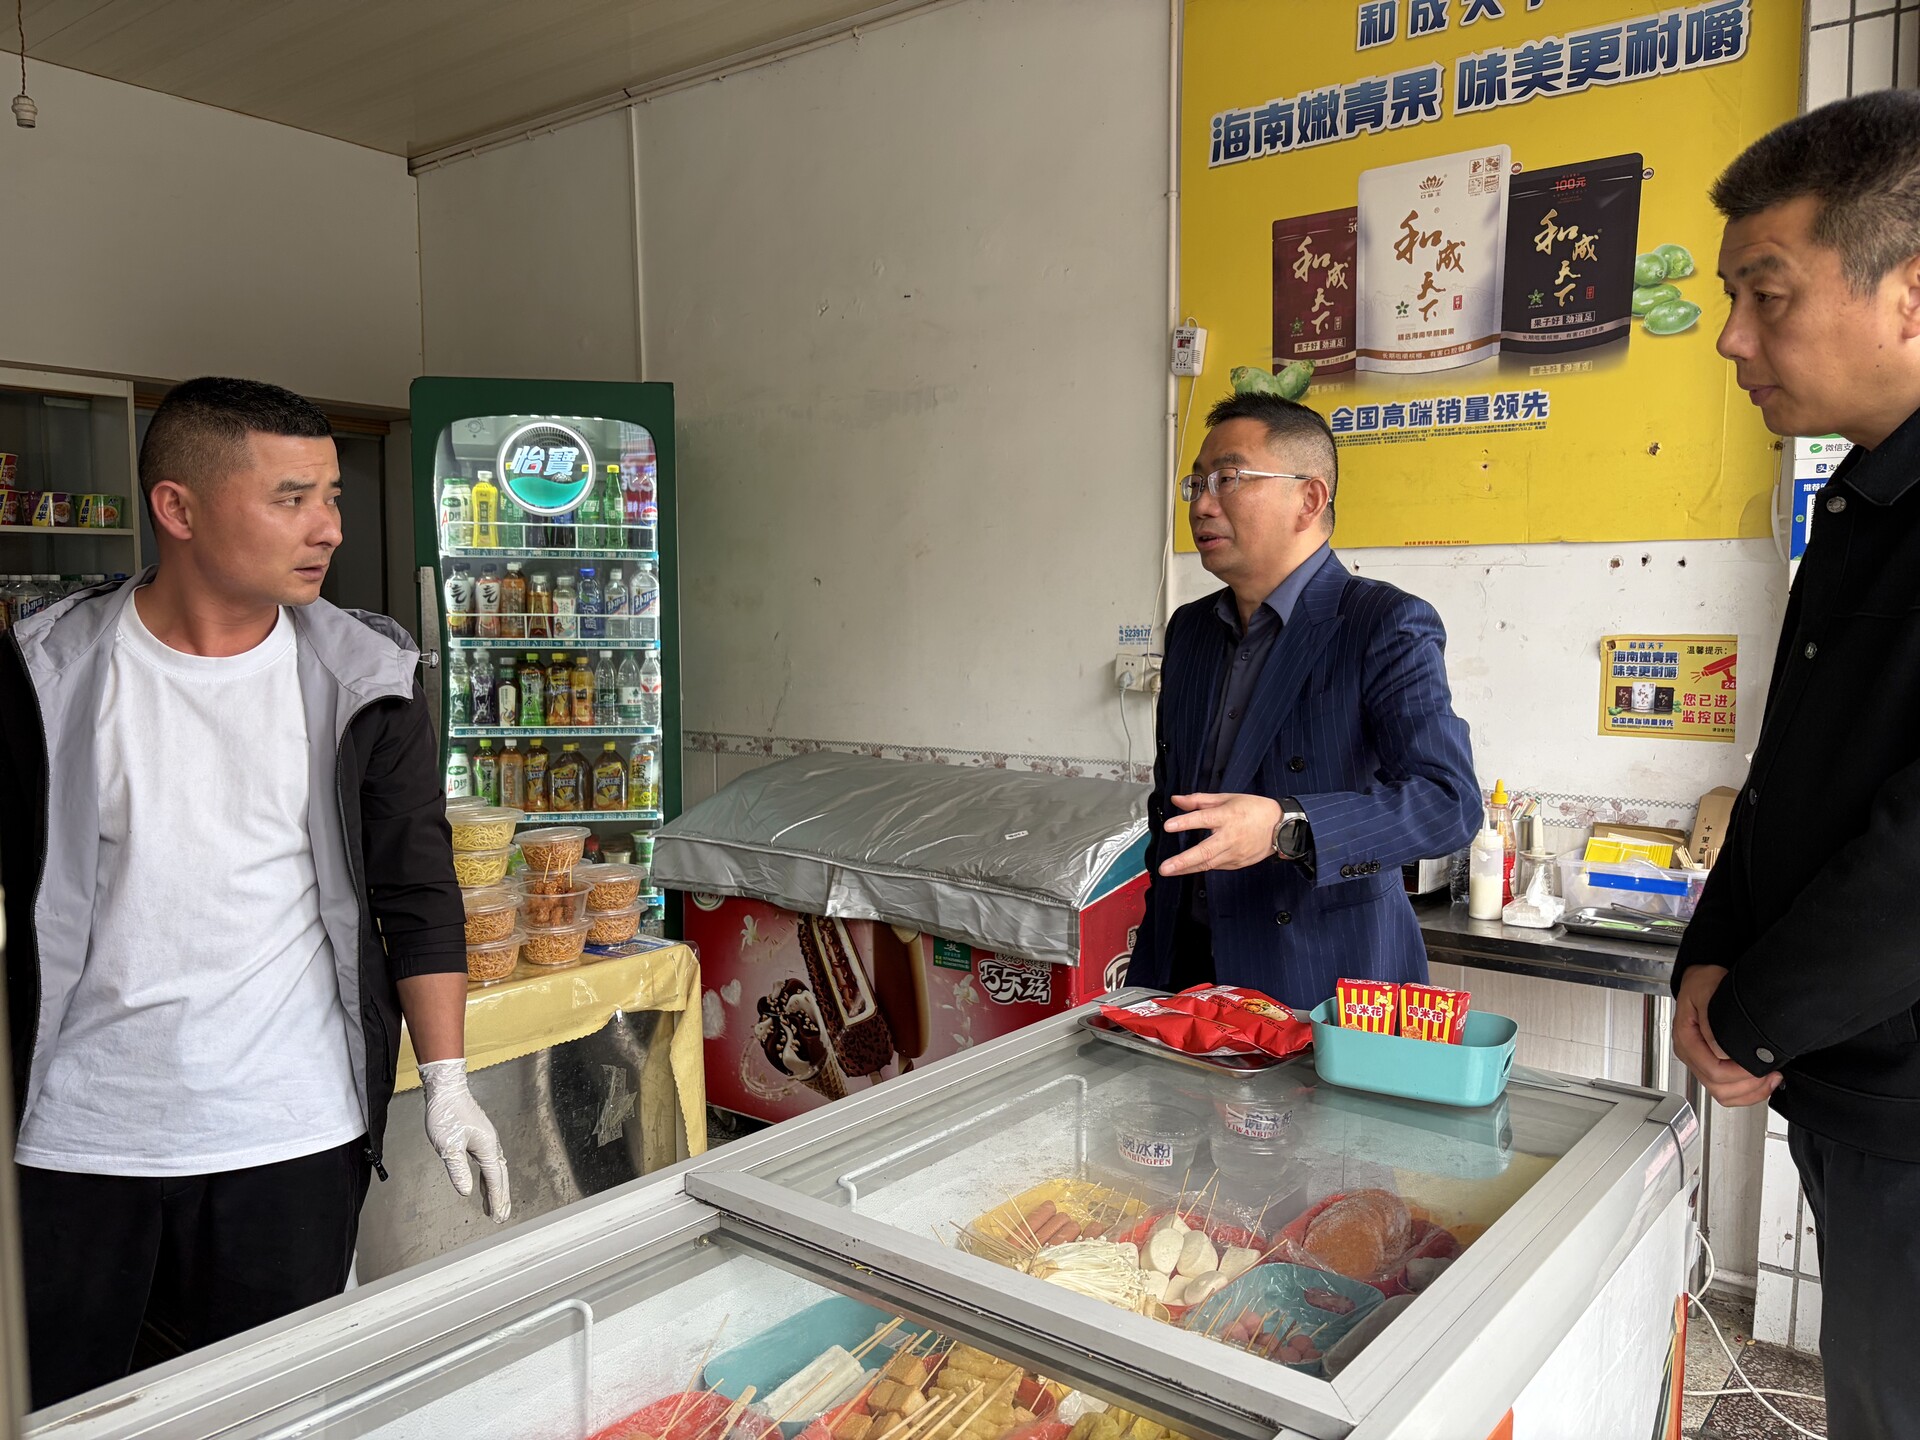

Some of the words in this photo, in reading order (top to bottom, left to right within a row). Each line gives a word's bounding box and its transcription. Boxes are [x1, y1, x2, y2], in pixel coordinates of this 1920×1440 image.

[1210, 64, 1441, 165] 海南嫩青果
[1456, 2, 1749, 112] 味美更耐嚼
[1555, 177, 1587, 191] 100元
[1394, 210, 1465, 322] 和成天下
[1534, 209, 1599, 307] 和成天下
[1293, 236, 1348, 334] 和成天下
[1331, 390, 1549, 433] 全国高端销量领先
[511, 446, 579, 476] 怡寶
[1825, 444, 1855, 452] 微信支
[1612, 665, 1677, 679] 味美更耐嚼
[1613, 651, 1678, 664] 海南嫩青果
[980, 960, 1051, 1004] 巧乐兹
[1346, 1003, 1383, 1018] 鸡米花
[1408, 1004, 1443, 1023] 鸡米花
